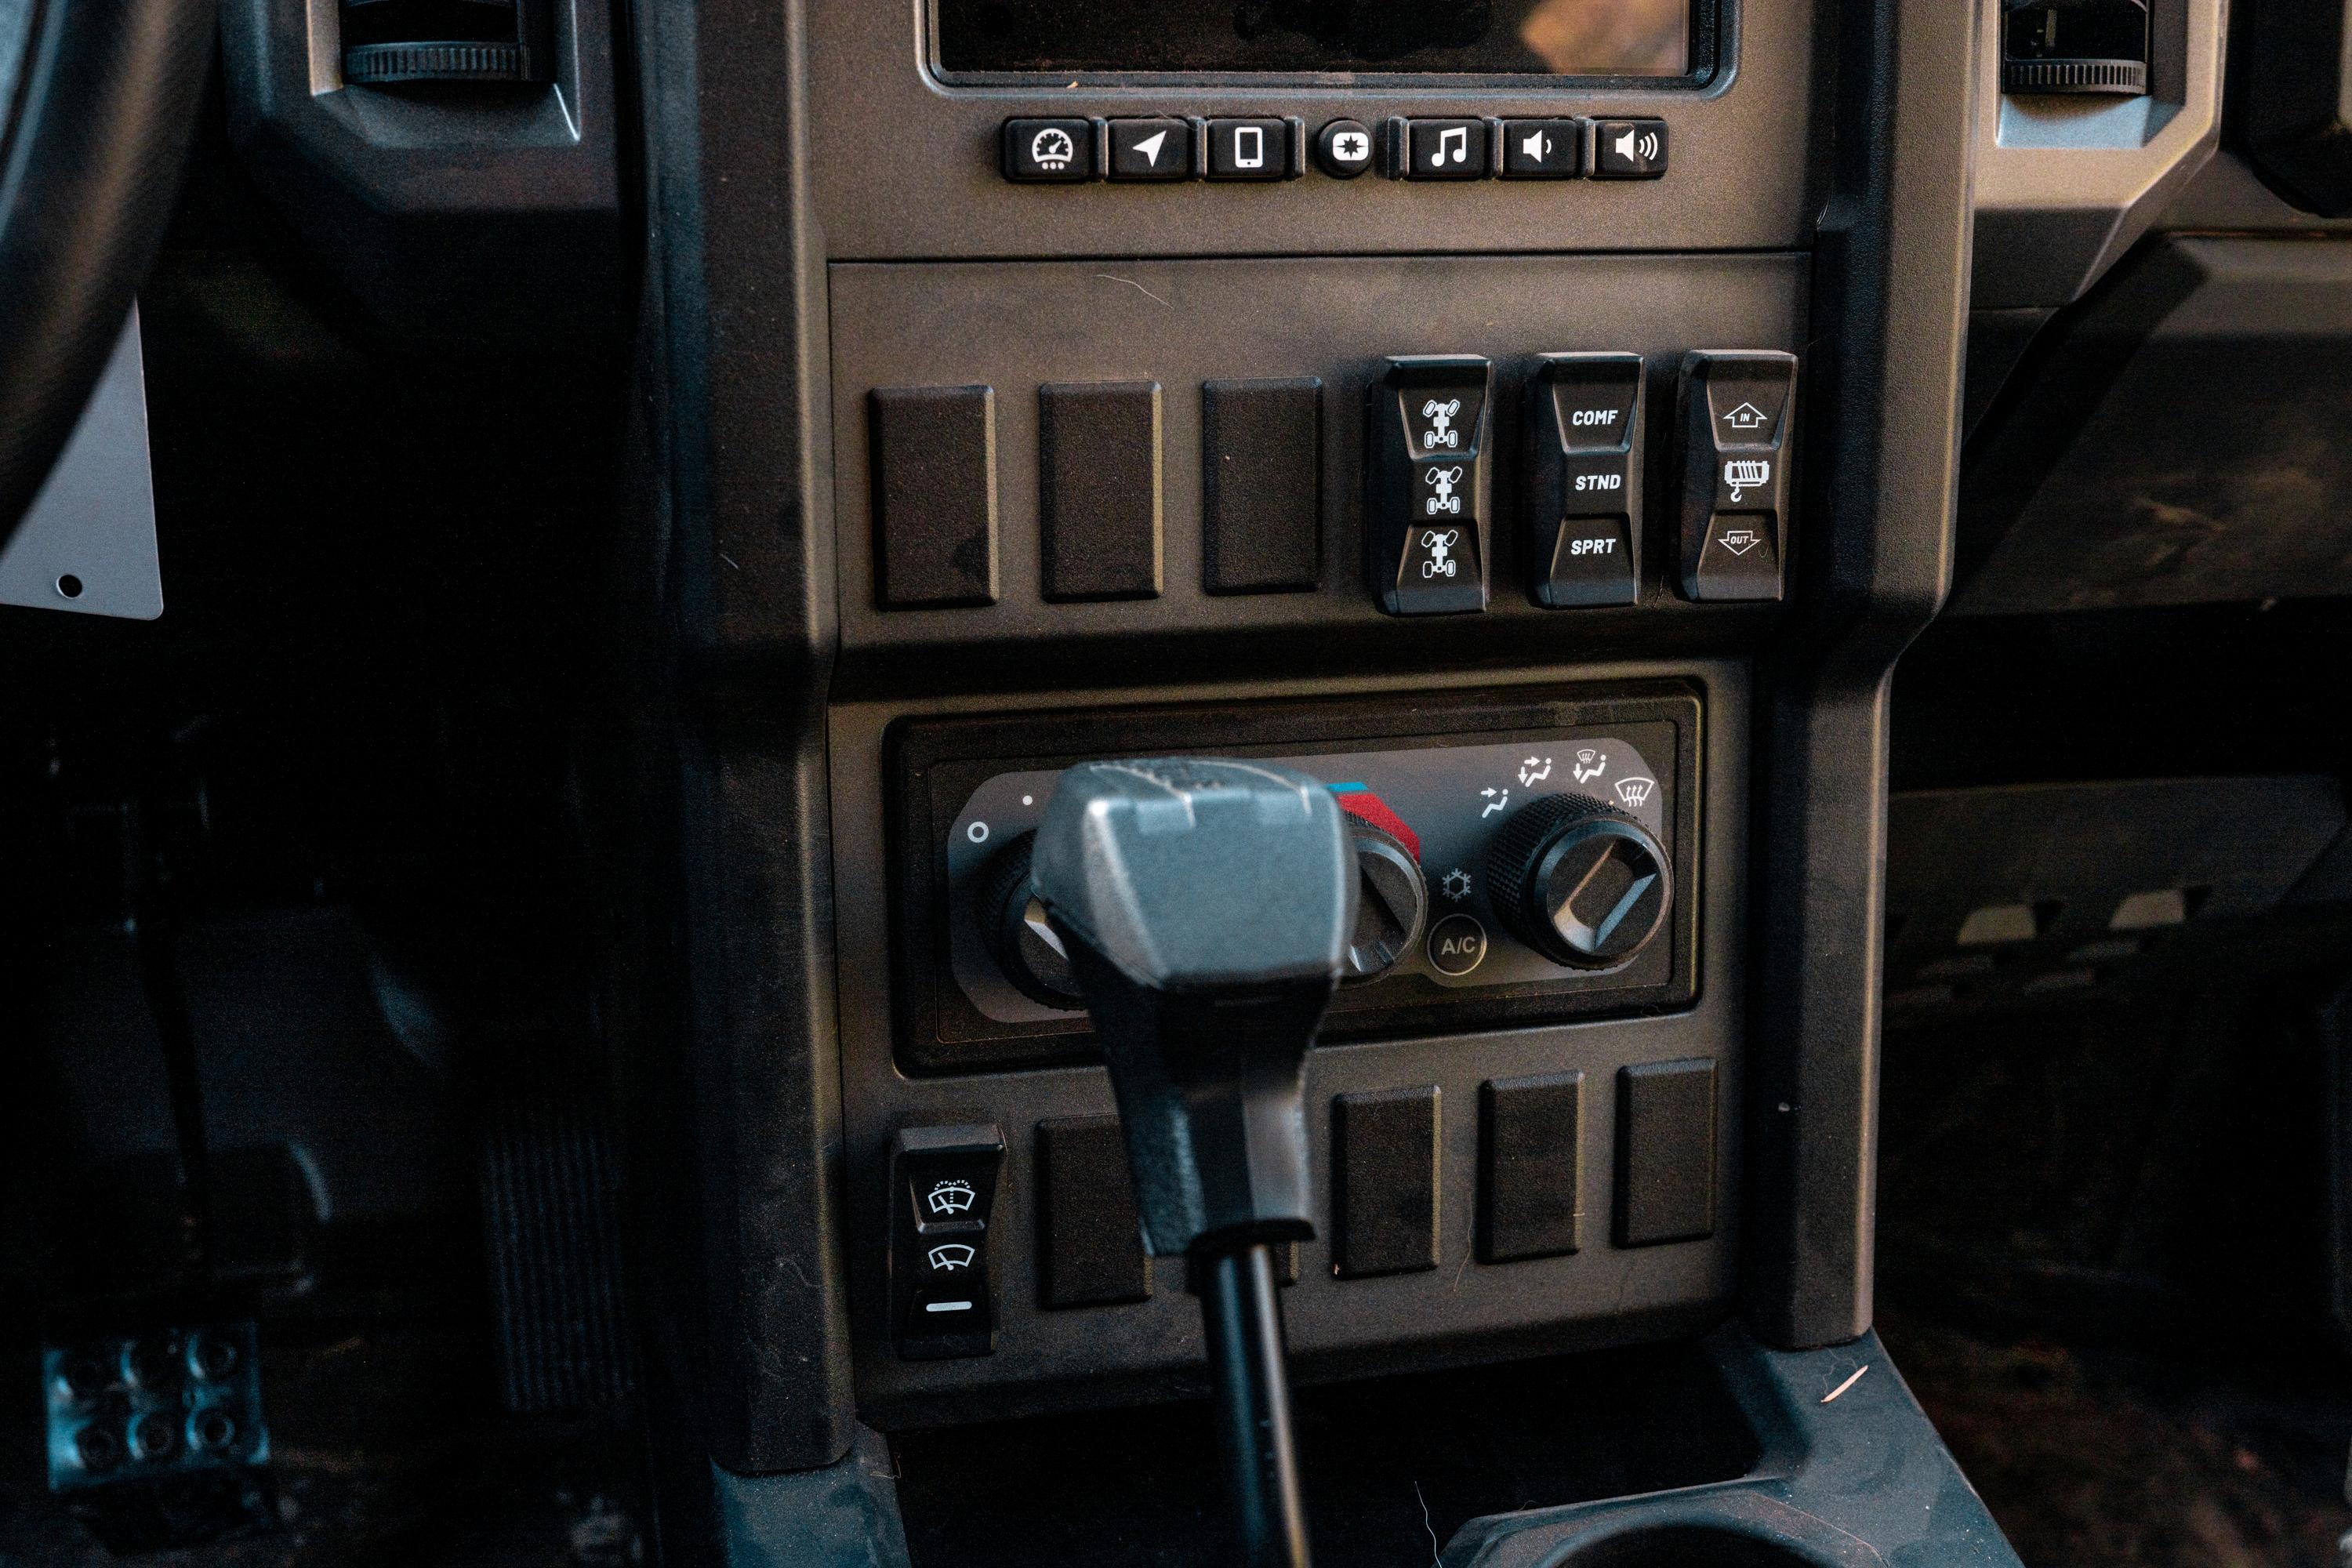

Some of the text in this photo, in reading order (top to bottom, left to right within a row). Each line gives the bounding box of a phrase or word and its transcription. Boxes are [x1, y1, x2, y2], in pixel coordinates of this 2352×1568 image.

[1572, 409, 1618, 426] COMF
[1740, 413, 1751, 422] IN
[1575, 474, 1621, 491] STND
[1570, 539, 1617, 555] SPRT
[1730, 535, 1749, 545] OUT
[1441, 936, 1475, 956] A/C
